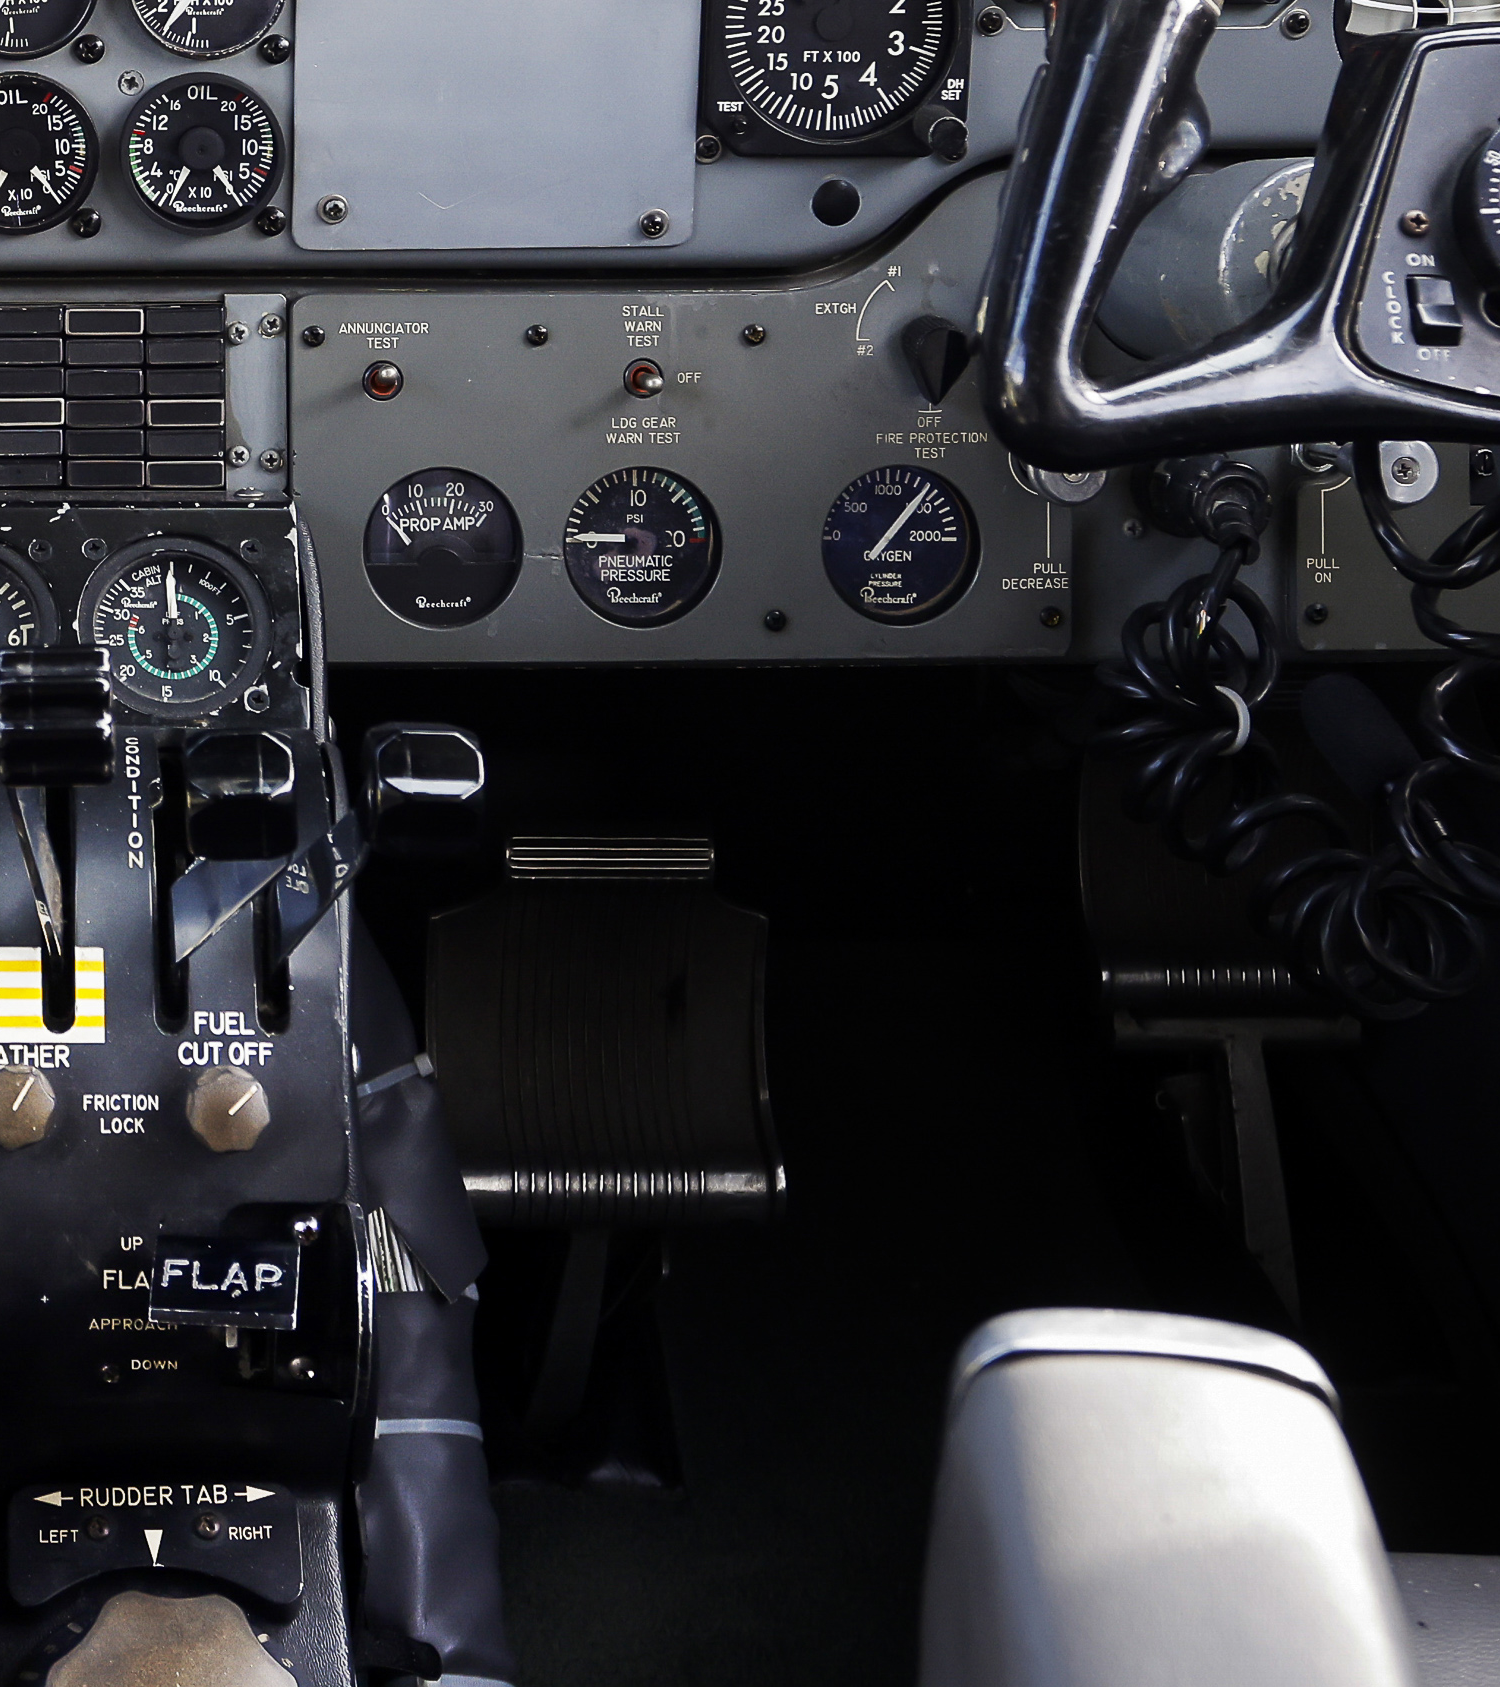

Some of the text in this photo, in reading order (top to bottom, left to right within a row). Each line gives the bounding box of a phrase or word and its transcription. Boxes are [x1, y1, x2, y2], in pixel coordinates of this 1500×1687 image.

[717, 101, 744, 112] TEST
[621, 305, 665, 319] STALL
[338, 321, 429, 336] ANNUNCIATOR
[624, 320, 662, 333] WARN
[876, 431, 989, 446] FIRE PROTECTION
[597, 555, 674, 570] PNEUMATIC
[600, 568, 672, 583] PRESSURE
[1002, 576, 1070, 590] DECREASE
[193, 1011, 255, 1037] FUEL
[177, 1041, 274, 1066] CUT OFF
[82, 1094, 160, 1111] FRICTION
[158, 1258, 285, 1291] FLAP
[80, 1484, 229, 1509] RUDDER TAB
[38, 1528, 80, 1545] LEFT
[227, 1525, 274, 1542] RIGHT
